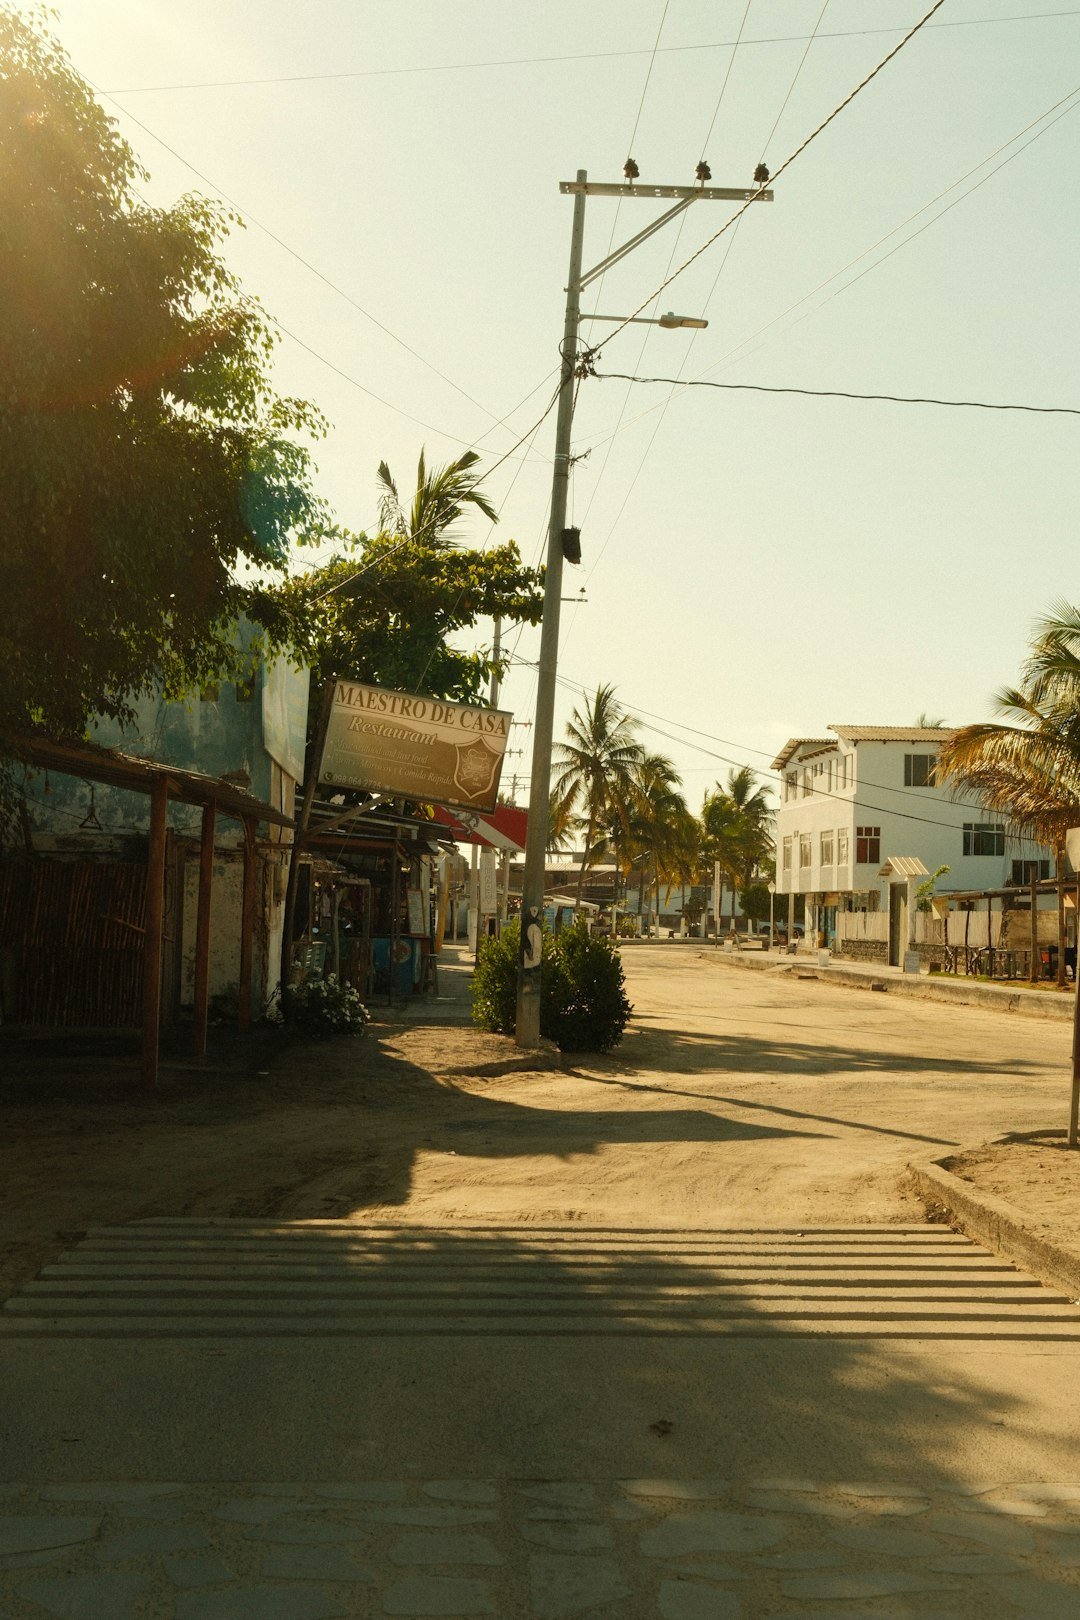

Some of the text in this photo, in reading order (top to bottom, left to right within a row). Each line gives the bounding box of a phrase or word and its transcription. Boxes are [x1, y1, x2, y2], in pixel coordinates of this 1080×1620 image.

[336, 685, 506, 735] MAESTRO DE CASA
[347, 715, 438, 746] Restaurant
